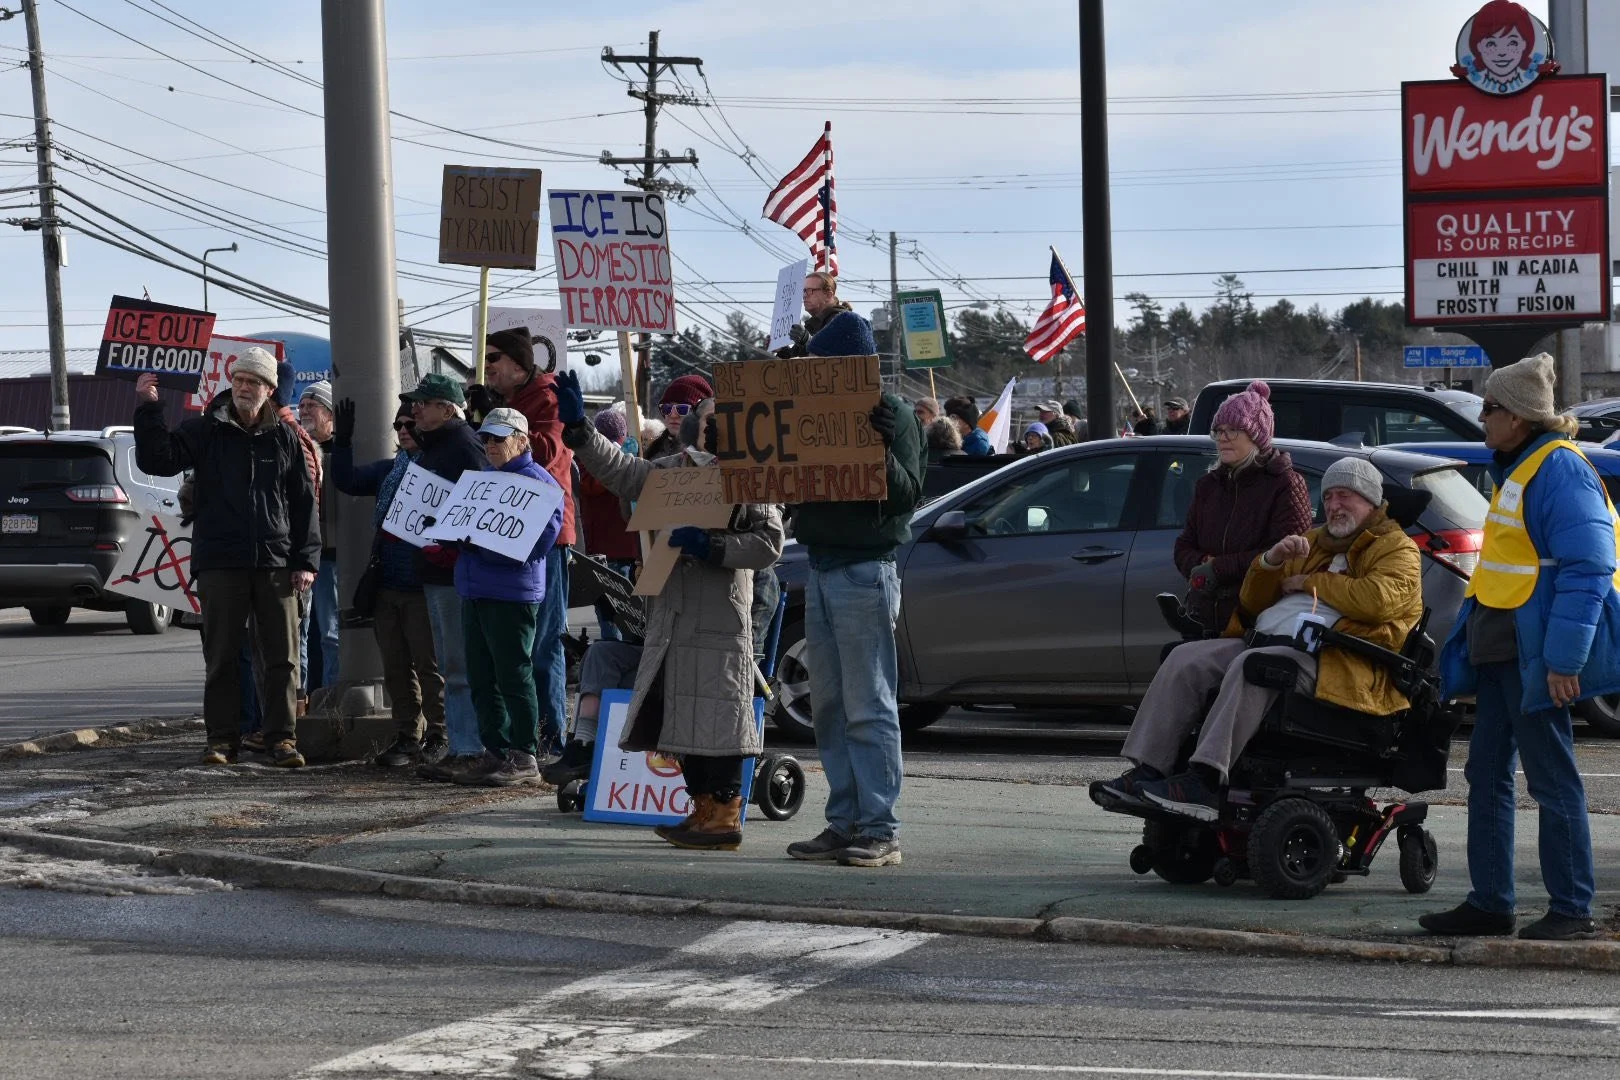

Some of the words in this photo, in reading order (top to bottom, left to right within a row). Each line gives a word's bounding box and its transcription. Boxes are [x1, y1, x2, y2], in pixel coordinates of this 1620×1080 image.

[1413, 95, 1593, 175] Wendy's
[454, 176, 525, 213] RESIST
[550, 192, 618, 238] ICE
[622, 193, 664, 239] IS
[1437, 210, 1575, 237] QUALITY
[444, 217, 531, 255] TYRANNY
[1437, 239, 1453, 252] IS
[1460, 237, 1500, 251] OUR
[1508, 234, 1575, 250] RECIPE
[557, 239, 672, 285] DOMESTIC
[1437, 262, 1479, 278] CHILL
[1492, 261, 1508, 276] IN
[1517, 258, 1579, 275] ACADIA
[1457, 279, 1500, 296] WITH
[1535, 278, 1546, 294] A
[559, 285, 675, 330] TERRORISM
[1437, 298, 1498, 315] FROSTY
[1517, 295, 1575, 313] FUSION
[112, 311, 154, 341] ICE
[158, 316, 205, 344] OUT
[107, 342, 149, 370] FOR
[151, 347, 202, 373] GOOD
[1460, 356, 1478, 365] Bank
[297, 369, 330, 381] oast
[713, 362, 746, 397] BE
[760, 358, 881, 396] CAREFUL
[715, 399, 798, 464] ICE
[797, 412, 849, 448] CAN
[462, 480, 498, 501] ICE
[500, 485, 540, 511] OUT
[656, 472, 700, 488] STOP
[720, 463, 886, 504] TREACHEROUS
[8, 496, 29, 504] Jeep
[2, 518, 18, 529] 928
[441, 504, 477, 527] FOR
[476, 508, 525, 539] GOOD
